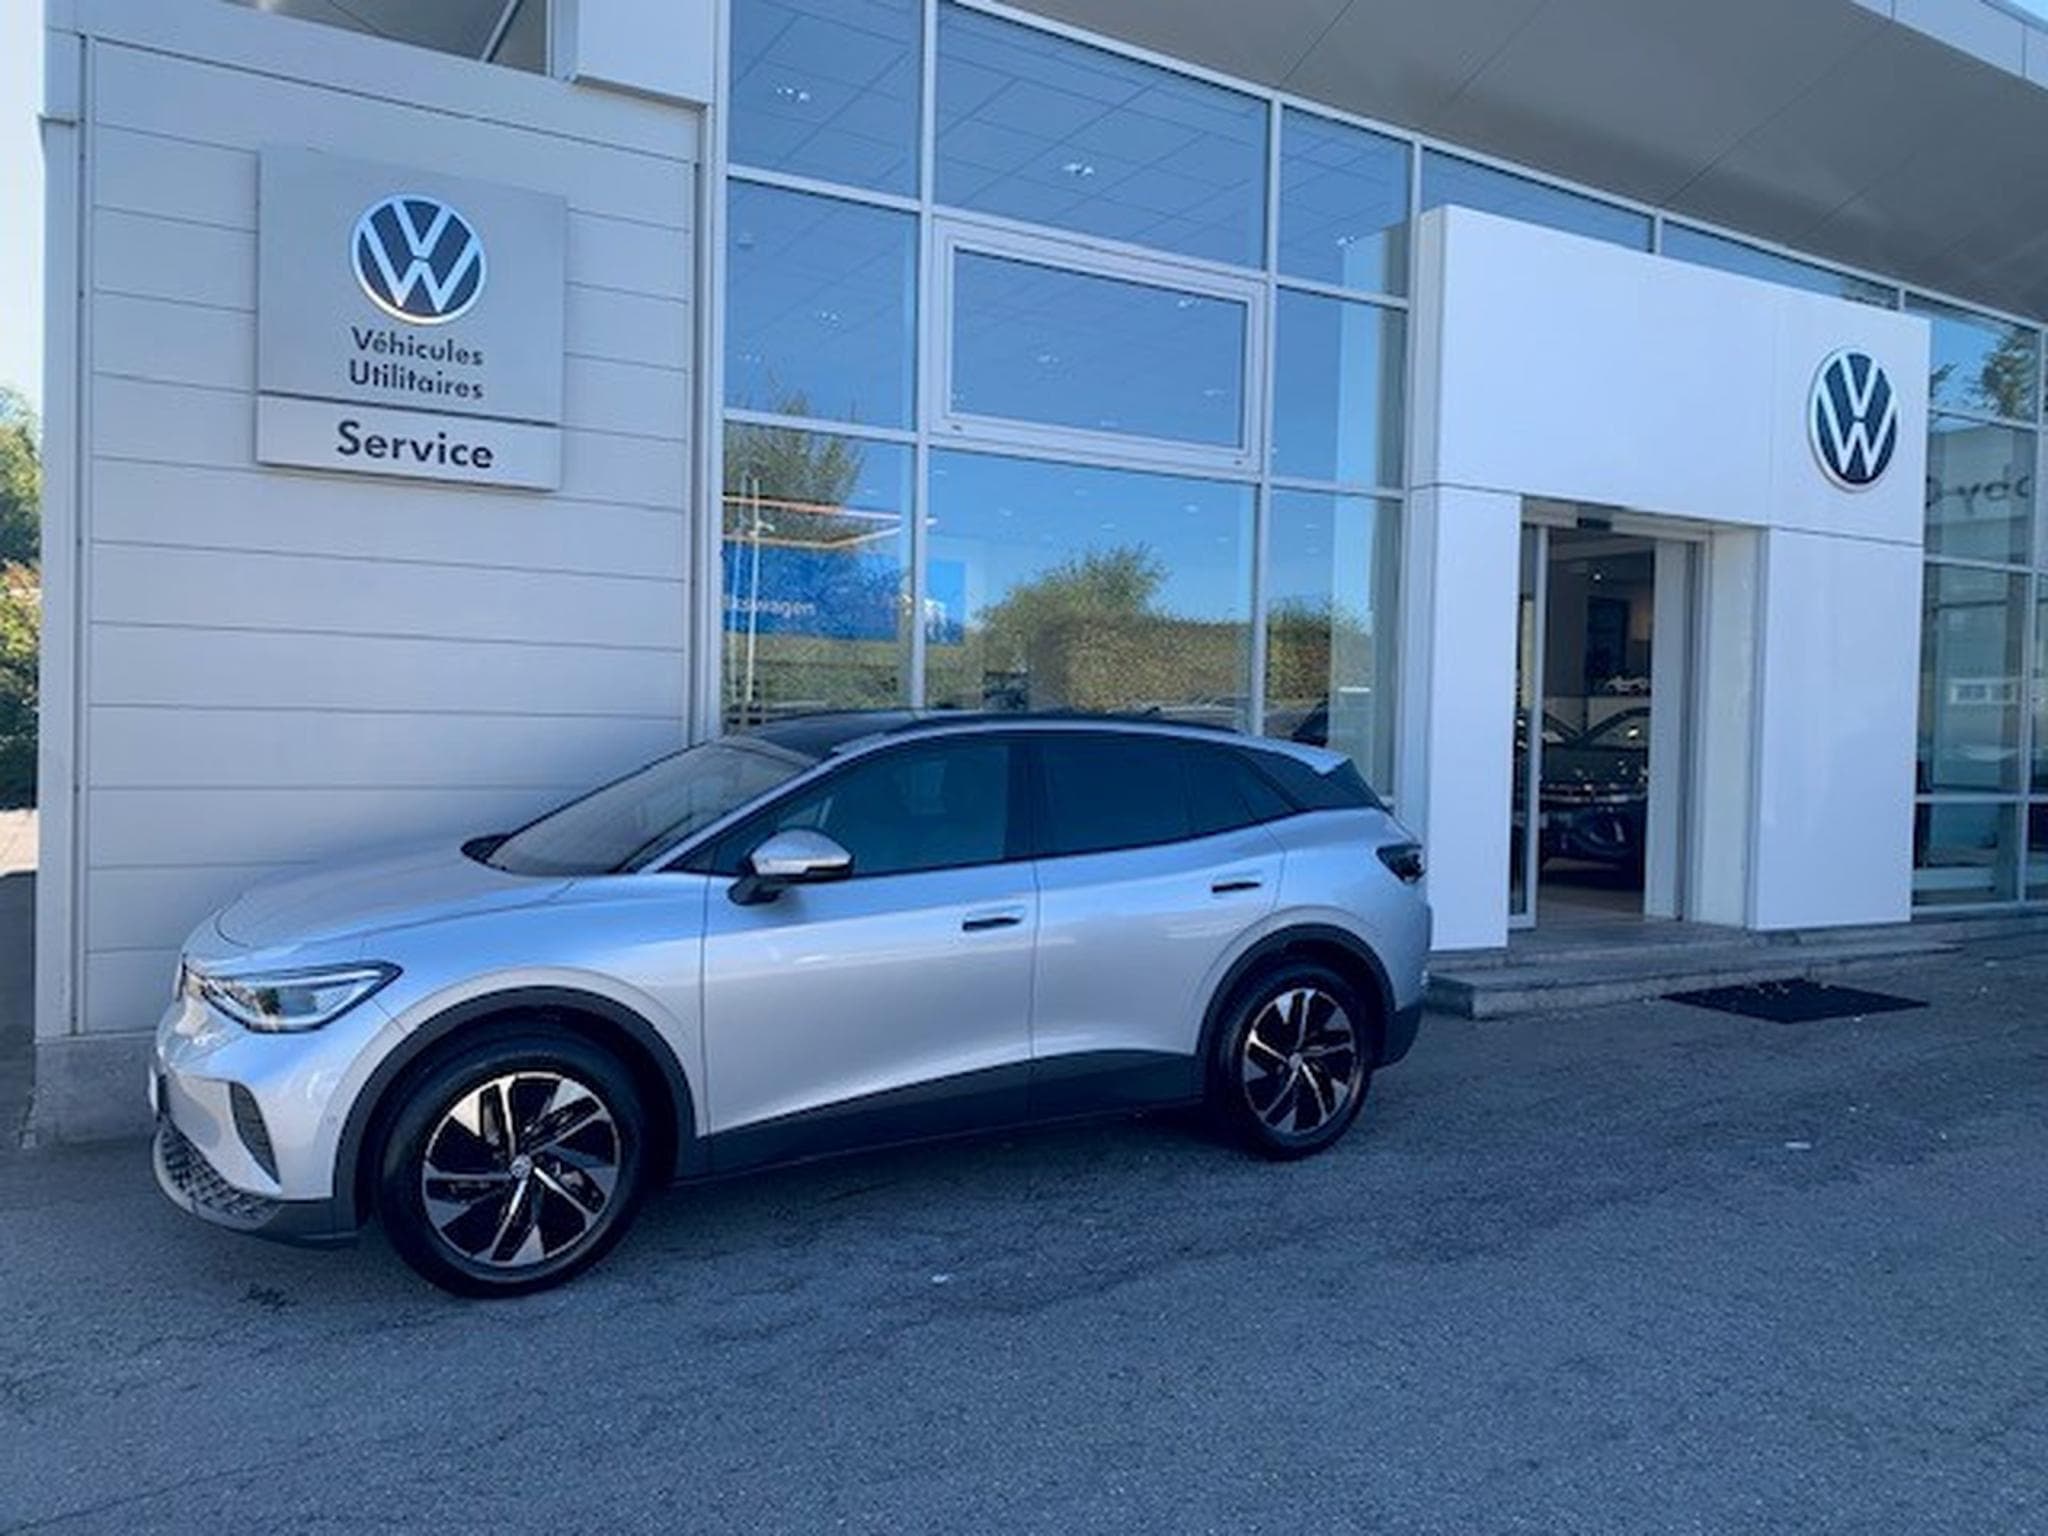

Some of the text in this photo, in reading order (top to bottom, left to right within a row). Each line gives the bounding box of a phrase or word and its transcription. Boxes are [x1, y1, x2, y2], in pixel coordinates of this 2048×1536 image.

[351, 326, 484, 366] Véhicules
[349, 360, 484, 399] Utilitaires
[337, 420, 494, 469] Service
